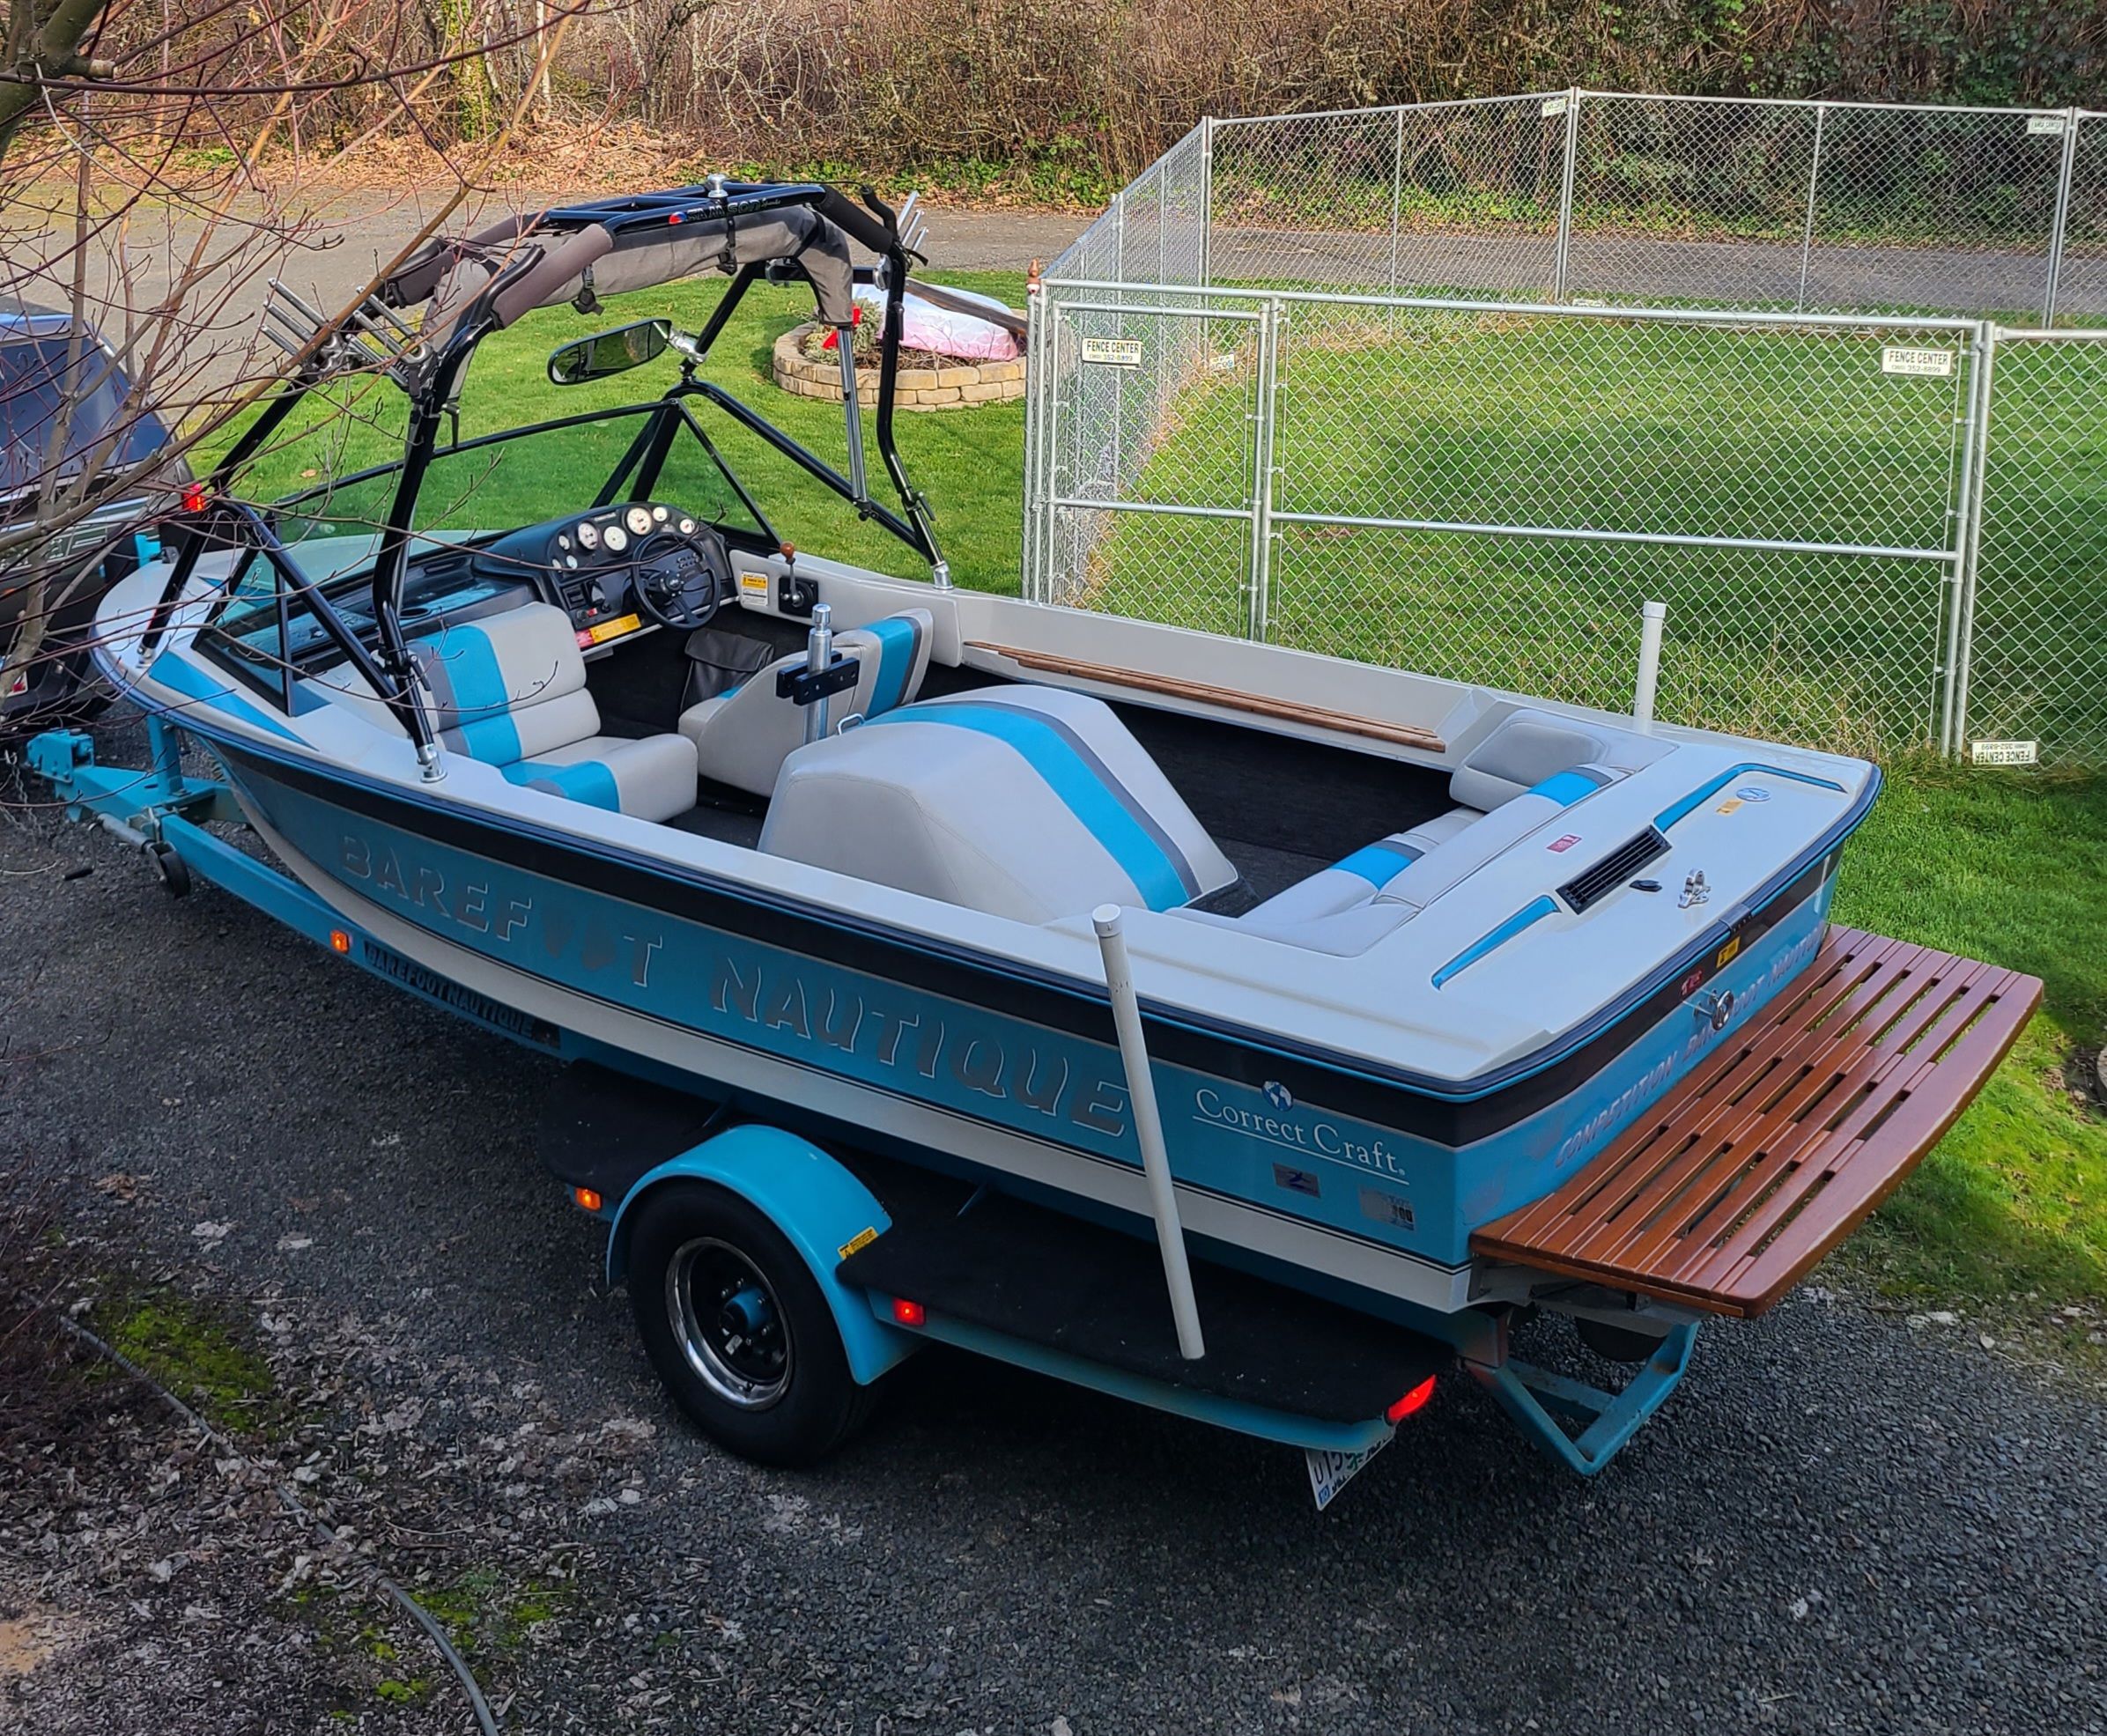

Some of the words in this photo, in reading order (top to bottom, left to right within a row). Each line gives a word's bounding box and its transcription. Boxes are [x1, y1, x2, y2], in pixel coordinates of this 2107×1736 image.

[1087, 340, 1109, 352] FENCE
[1112, 342, 1139, 353] CENTER
[1889, 351, 1915, 363] FENCE
[1917, 352, 1948, 365] CENTER
[1975, 751, 2004, 763] CENTER
[2006, 750, 2030, 763] FENCE
[709, 954, 1131, 1138] NAUTIQUE
[1195, 1088, 1307, 1145] Correct
[1312, 1123, 1400, 1176] Craft
